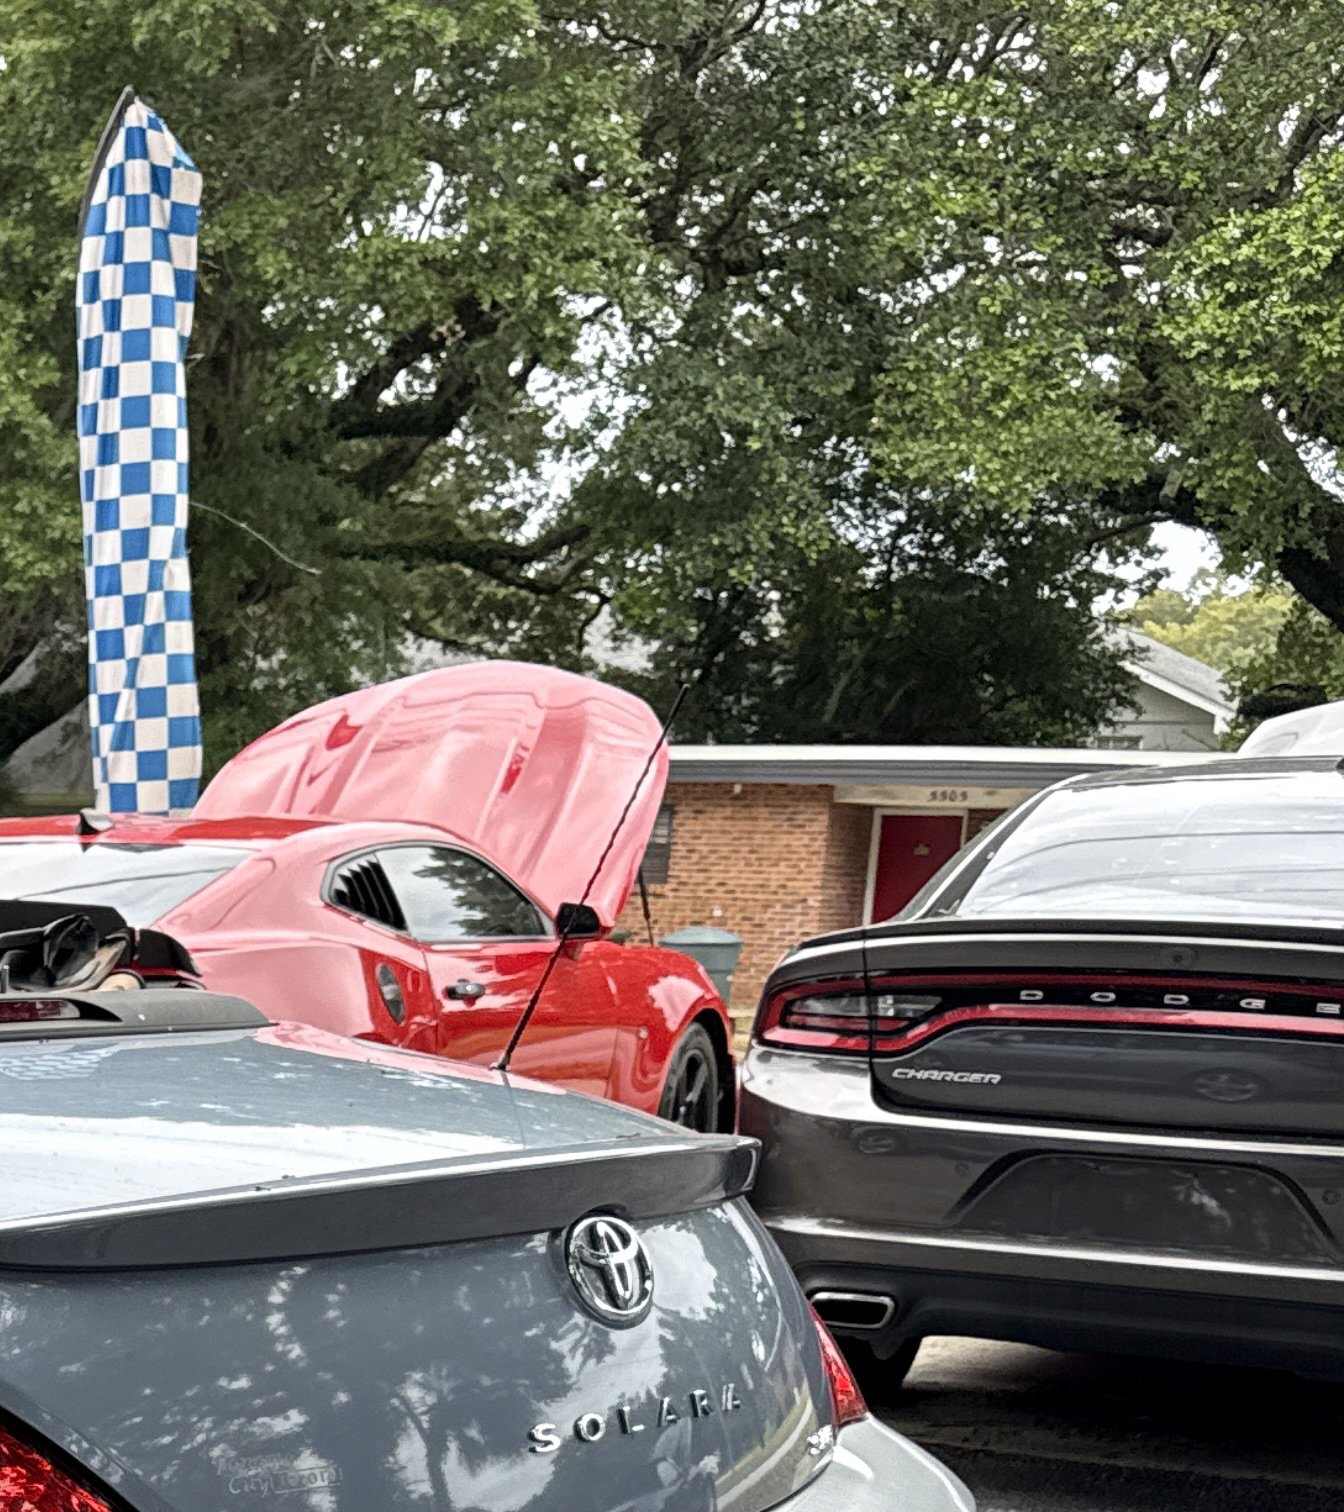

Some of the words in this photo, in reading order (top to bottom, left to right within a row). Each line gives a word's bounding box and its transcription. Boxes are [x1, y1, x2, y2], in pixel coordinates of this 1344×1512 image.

[1019, 988, 1342, 1015] DODGE
[892, 1067, 1002, 1085] CHARGER
[528, 1383, 741, 1454] SOLARA
